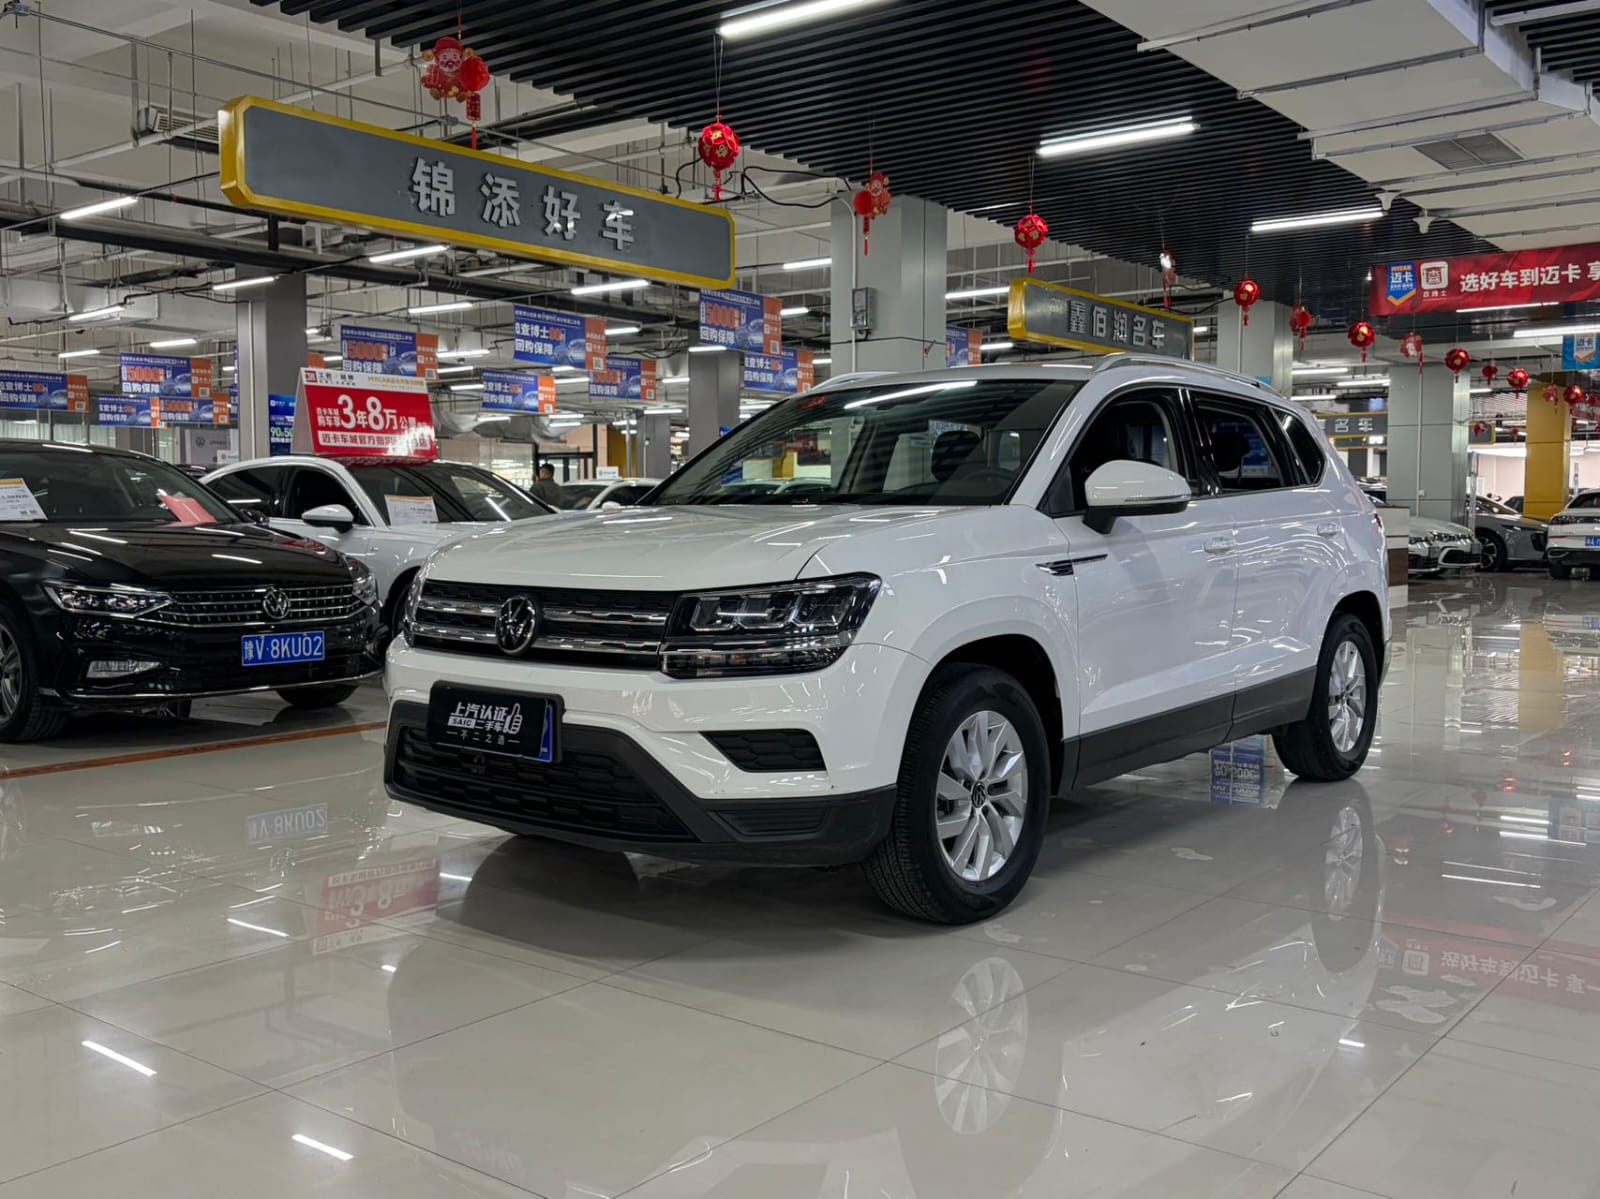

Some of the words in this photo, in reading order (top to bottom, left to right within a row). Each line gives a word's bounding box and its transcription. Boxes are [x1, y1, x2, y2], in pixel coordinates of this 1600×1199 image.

[412, 157, 635, 251] 锦添好车
[1391, 272, 1413, 284] 迈卡
[1460, 263, 1582, 293] 选好车到迈卡
[515, 338, 553, 356] 回购保障
[451, 701, 509, 722] 上汽认证
[474, 719, 505, 733] 二手车
